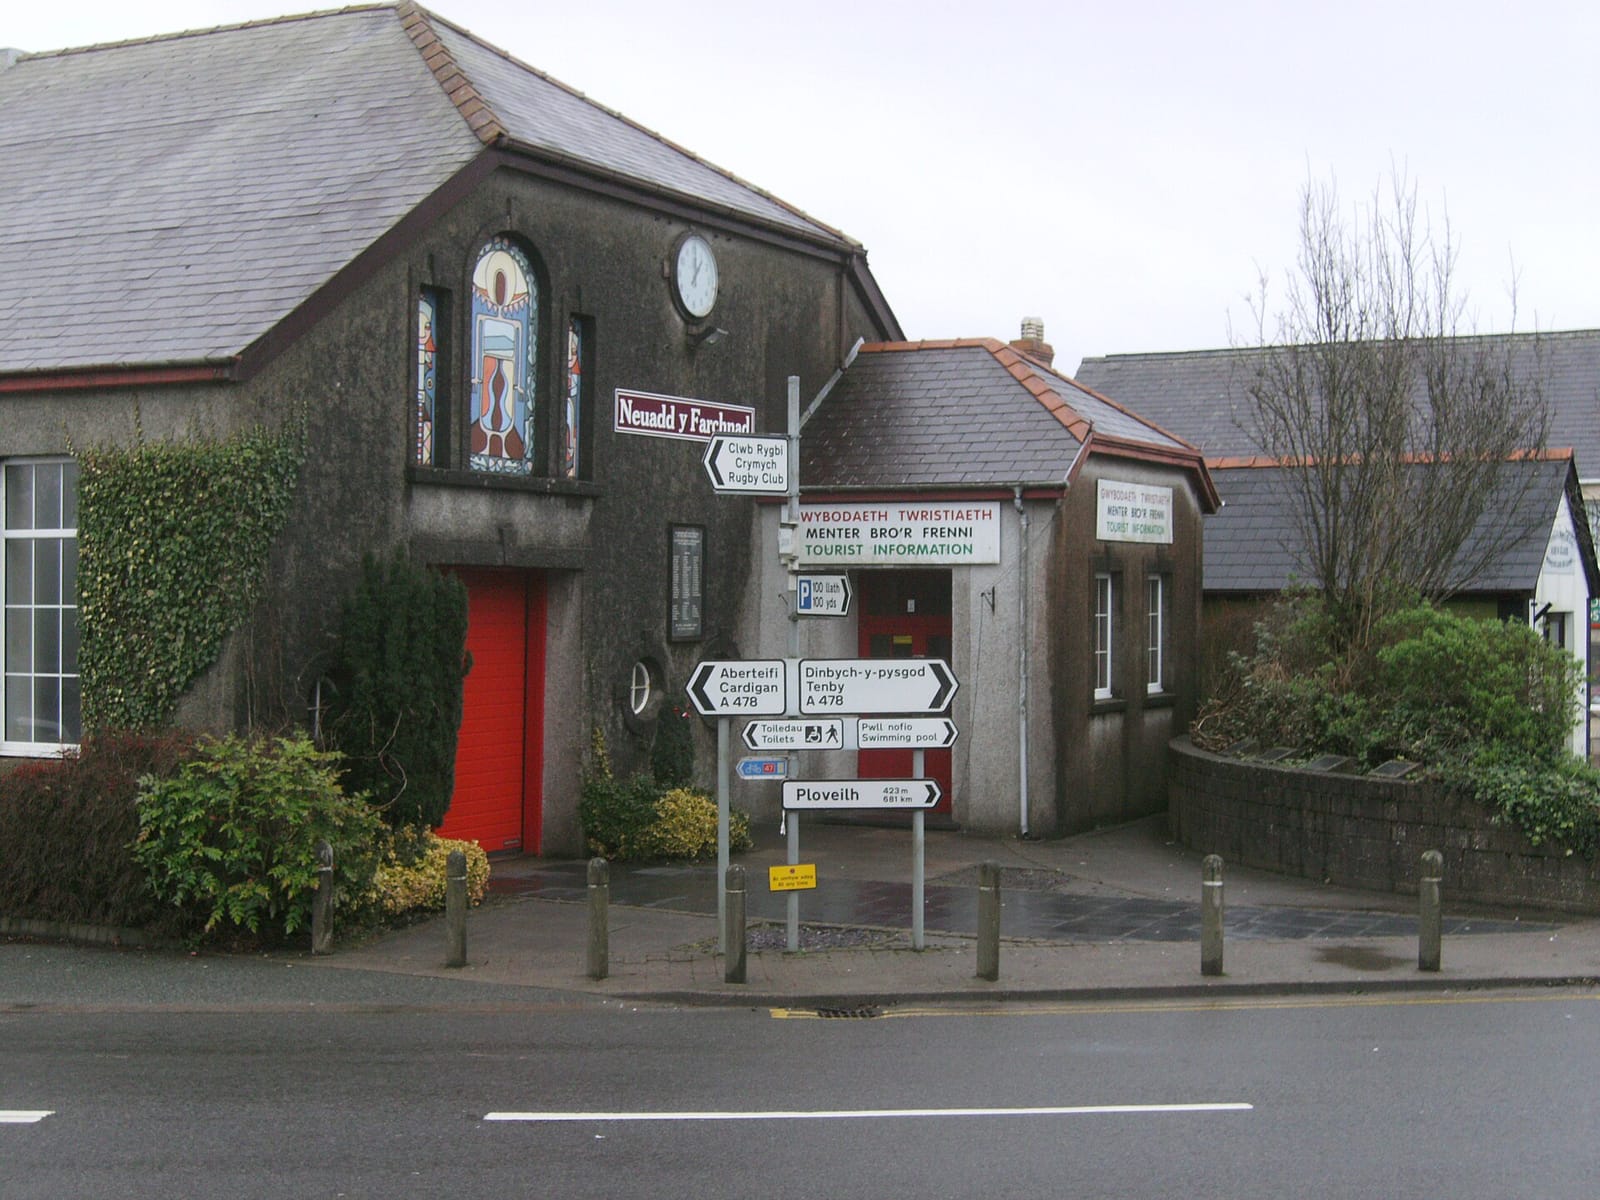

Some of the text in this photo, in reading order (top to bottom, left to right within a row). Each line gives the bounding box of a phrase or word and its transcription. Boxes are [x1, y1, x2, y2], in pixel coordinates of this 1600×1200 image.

[619, 398, 750, 433] Neuadd y Farchnad
[728, 442, 784, 457] Clwb Rygbi
[735, 458, 777, 471] Crymych
[728, 472, 784, 485] Rugby Club
[801, 509, 993, 522] WYBODAETH TWRISTIAETH
[1107, 505, 1128, 517] MENTER
[1106, 521, 1129, 532] TOURIST
[806, 527, 973, 539] MENTER BRO'R FRENNI
[806, 544, 973, 556] TOURIST INFORMATION
[813, 581, 840, 593] 100 llath
[800, 581, 810, 607] P
[813, 596, 837, 610] 100 yds
[720, 667, 778, 679] Aberteifi
[720, 682, 778, 696] Cardigan
[806, 681, 844, 695] Tenby
[720, 697, 758, 707] A 478
[806, 696, 844, 706] A 478
[761, 724, 802, 733] Toiledau
[862, 723, 913, 732] Pwll nofio
[761, 735, 795, 743] Toilets
[862, 733, 937, 744] Swimming pool
[796, 788, 859, 801] Ploveilh
[883, 787, 899, 795] 423
